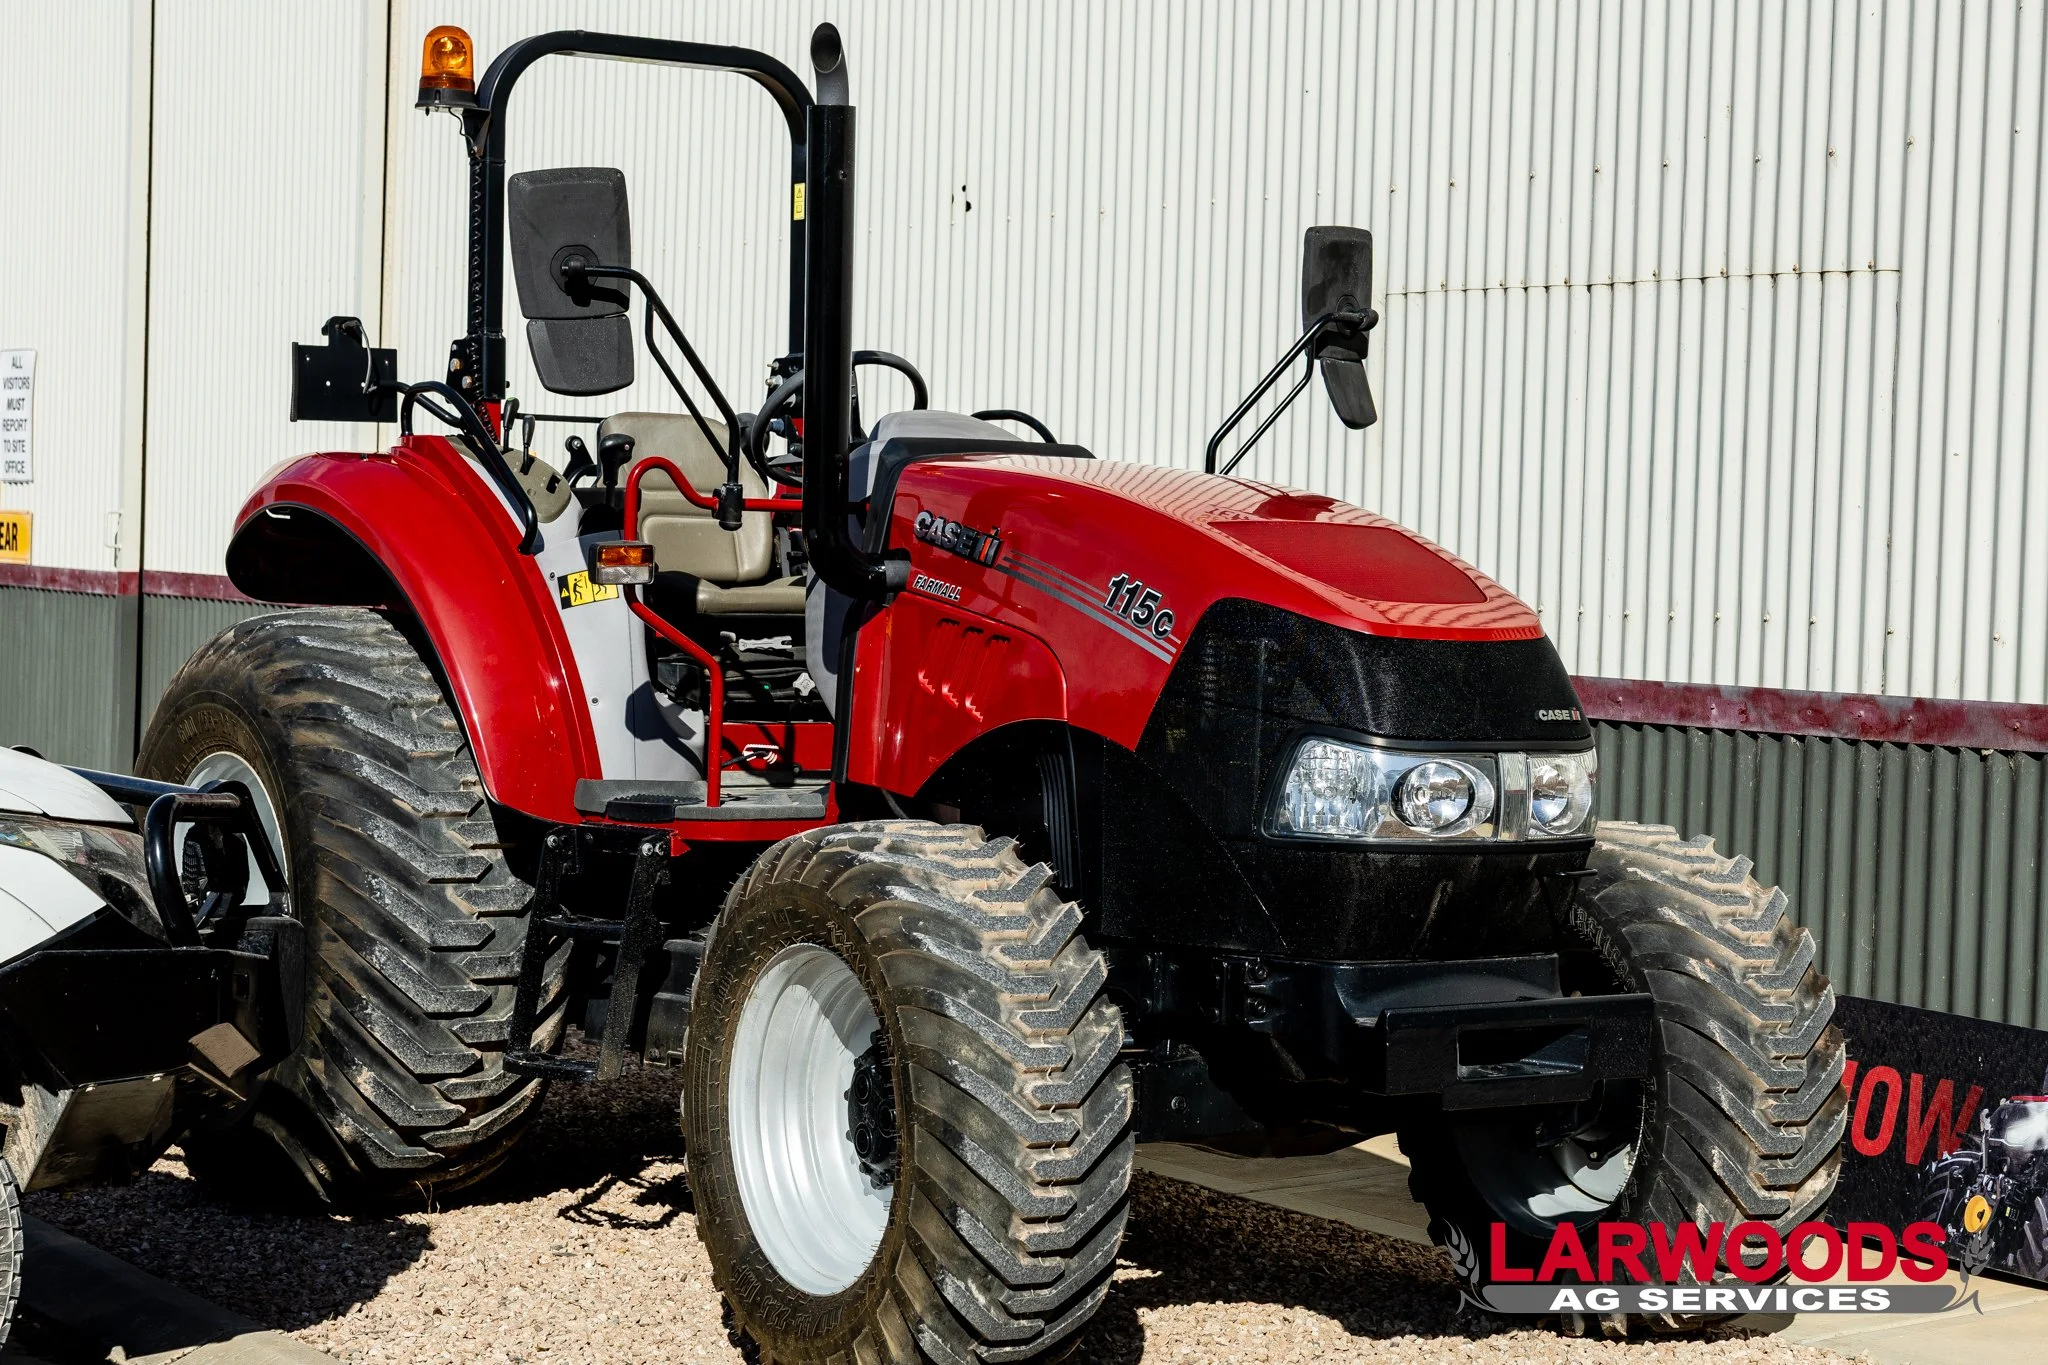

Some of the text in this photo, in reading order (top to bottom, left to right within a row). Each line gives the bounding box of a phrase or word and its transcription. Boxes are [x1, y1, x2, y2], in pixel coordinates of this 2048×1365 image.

[11, 355, 23, 369] ALL
[3, 376, 30, 390] VISITORS
[6, 397, 25, 411] MUST
[2, 418, 28, 432] REPORT
[4, 439, 26, 453] TO SITE
[5, 460, 25, 474] OFFICE
[914, 510, 978, 557] CASE
[912, 573, 962, 602] FARMALL
[1538, 709, 1571, 721] CASE
